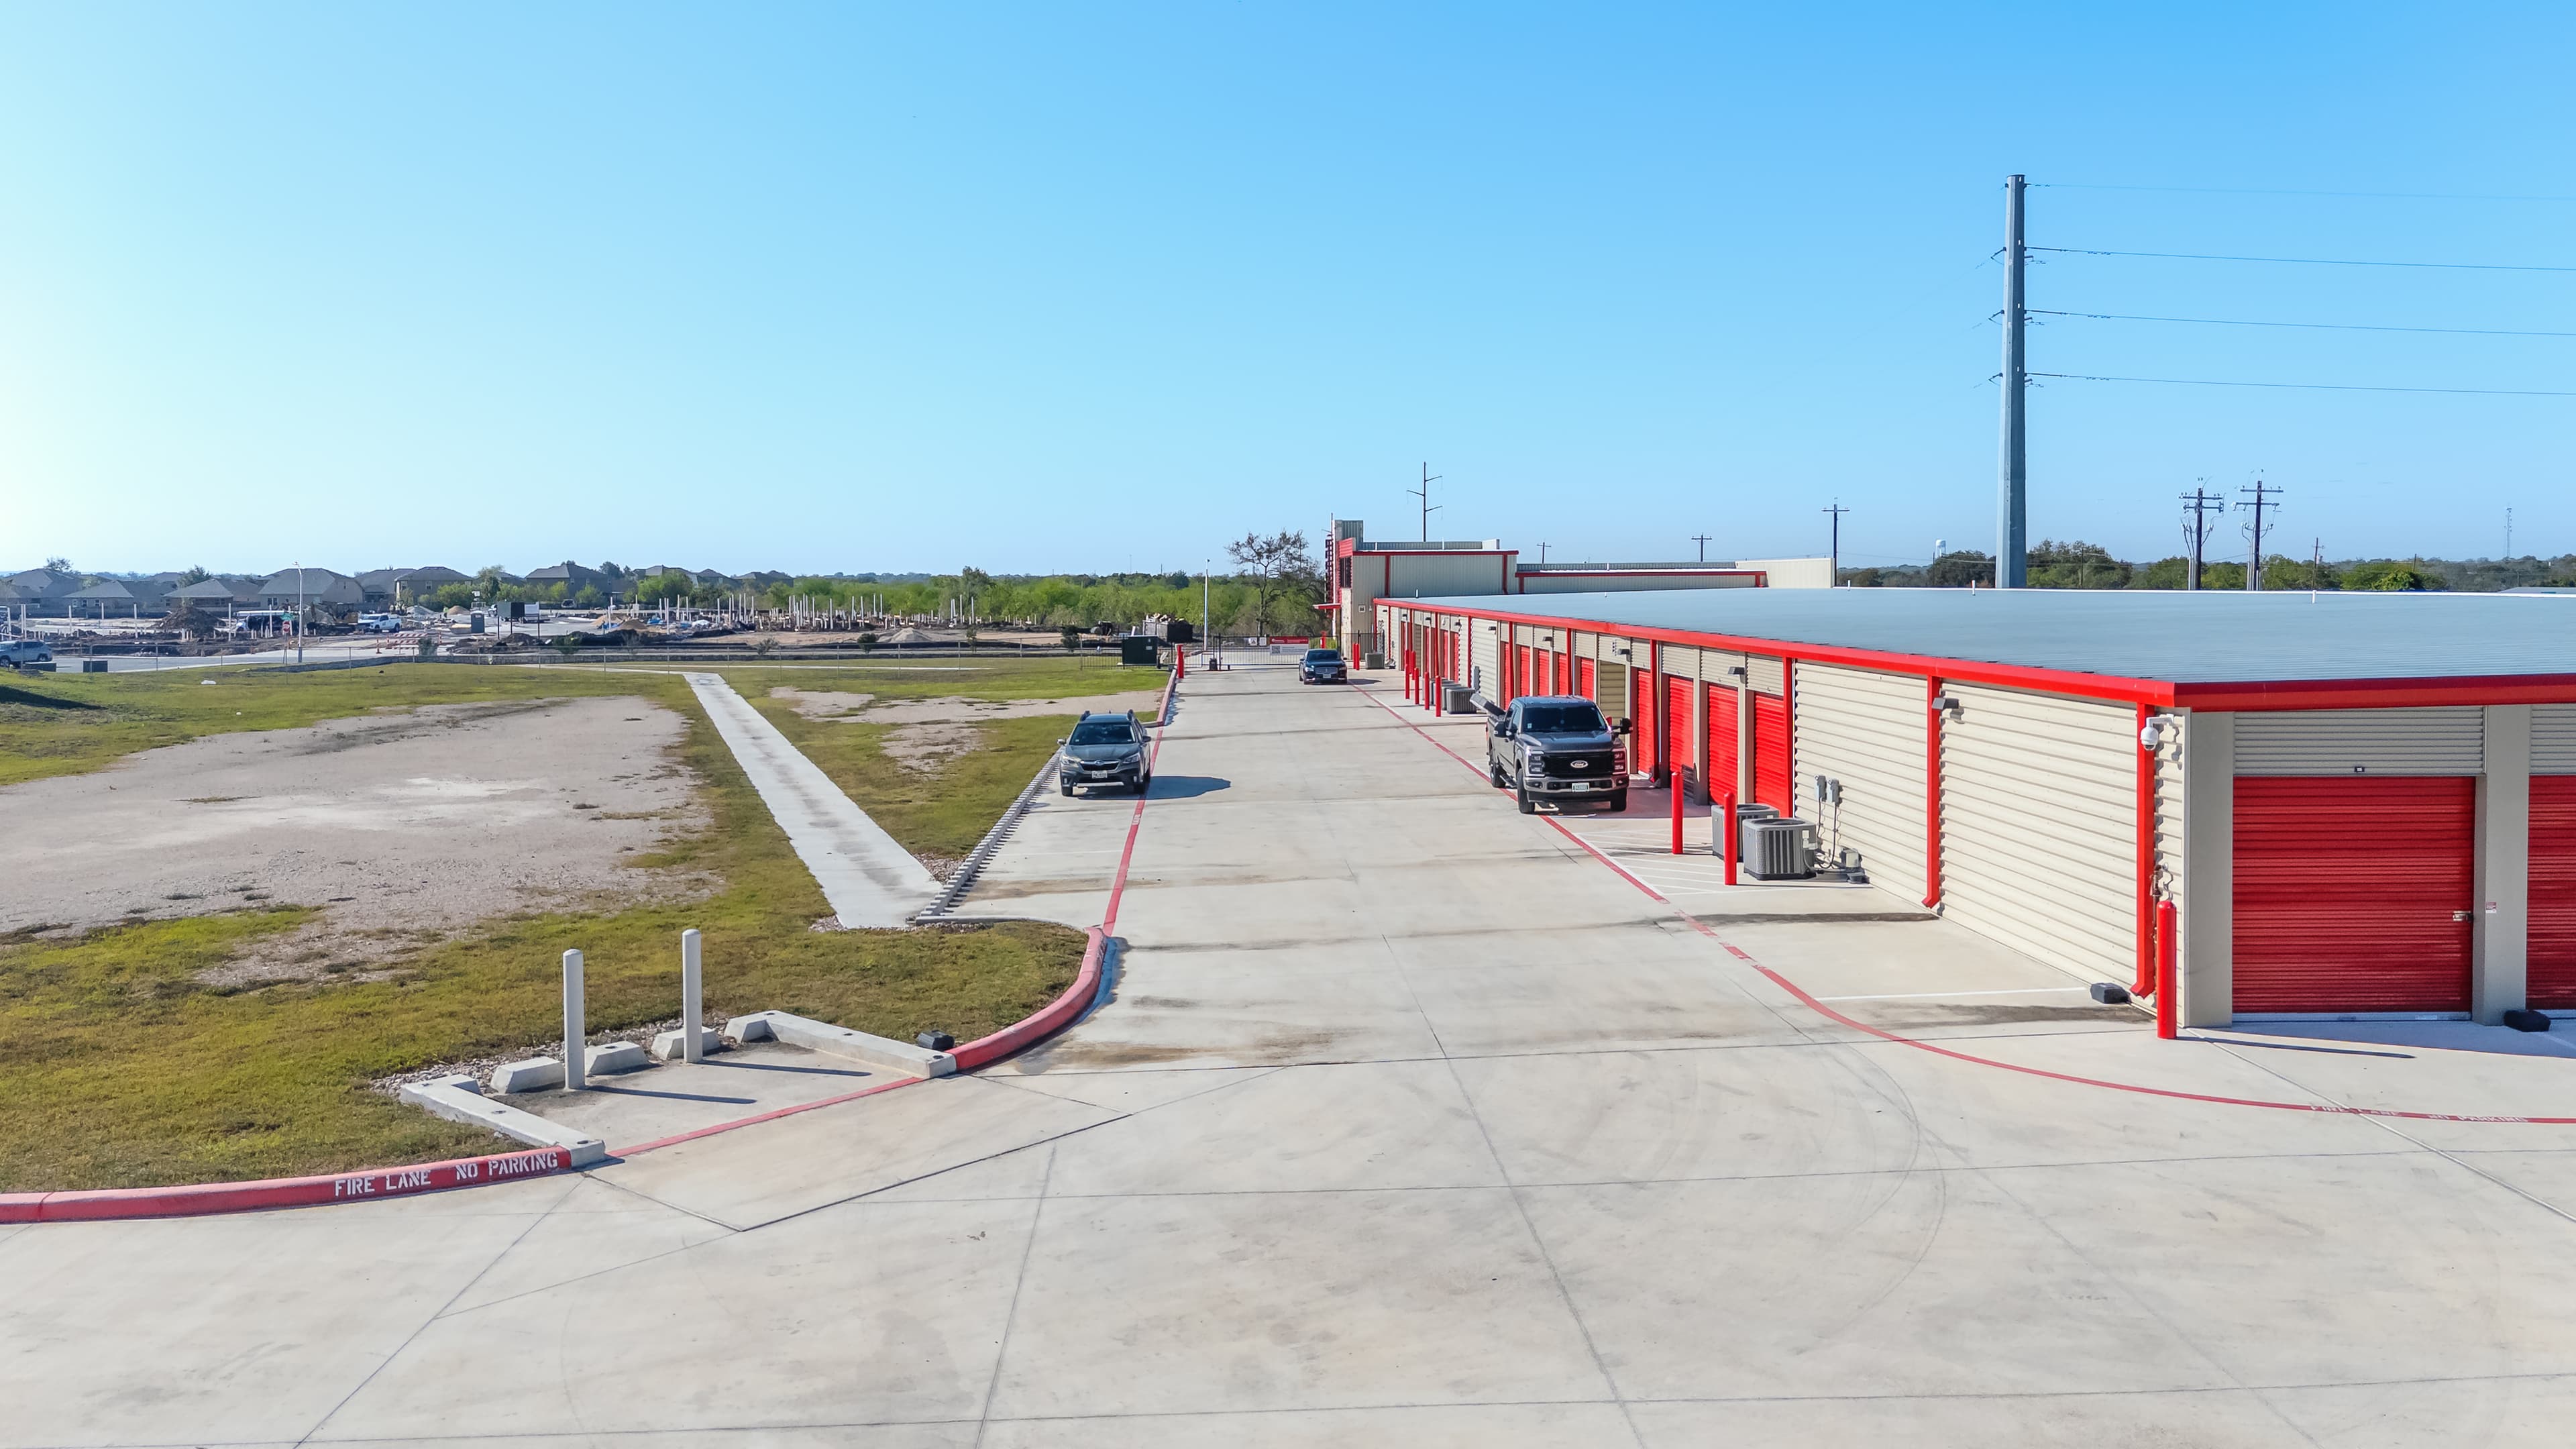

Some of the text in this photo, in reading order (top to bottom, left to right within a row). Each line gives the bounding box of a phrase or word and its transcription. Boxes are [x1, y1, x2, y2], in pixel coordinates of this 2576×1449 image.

[334, 1151, 559, 1197] FIRE LANE NO PARKING
